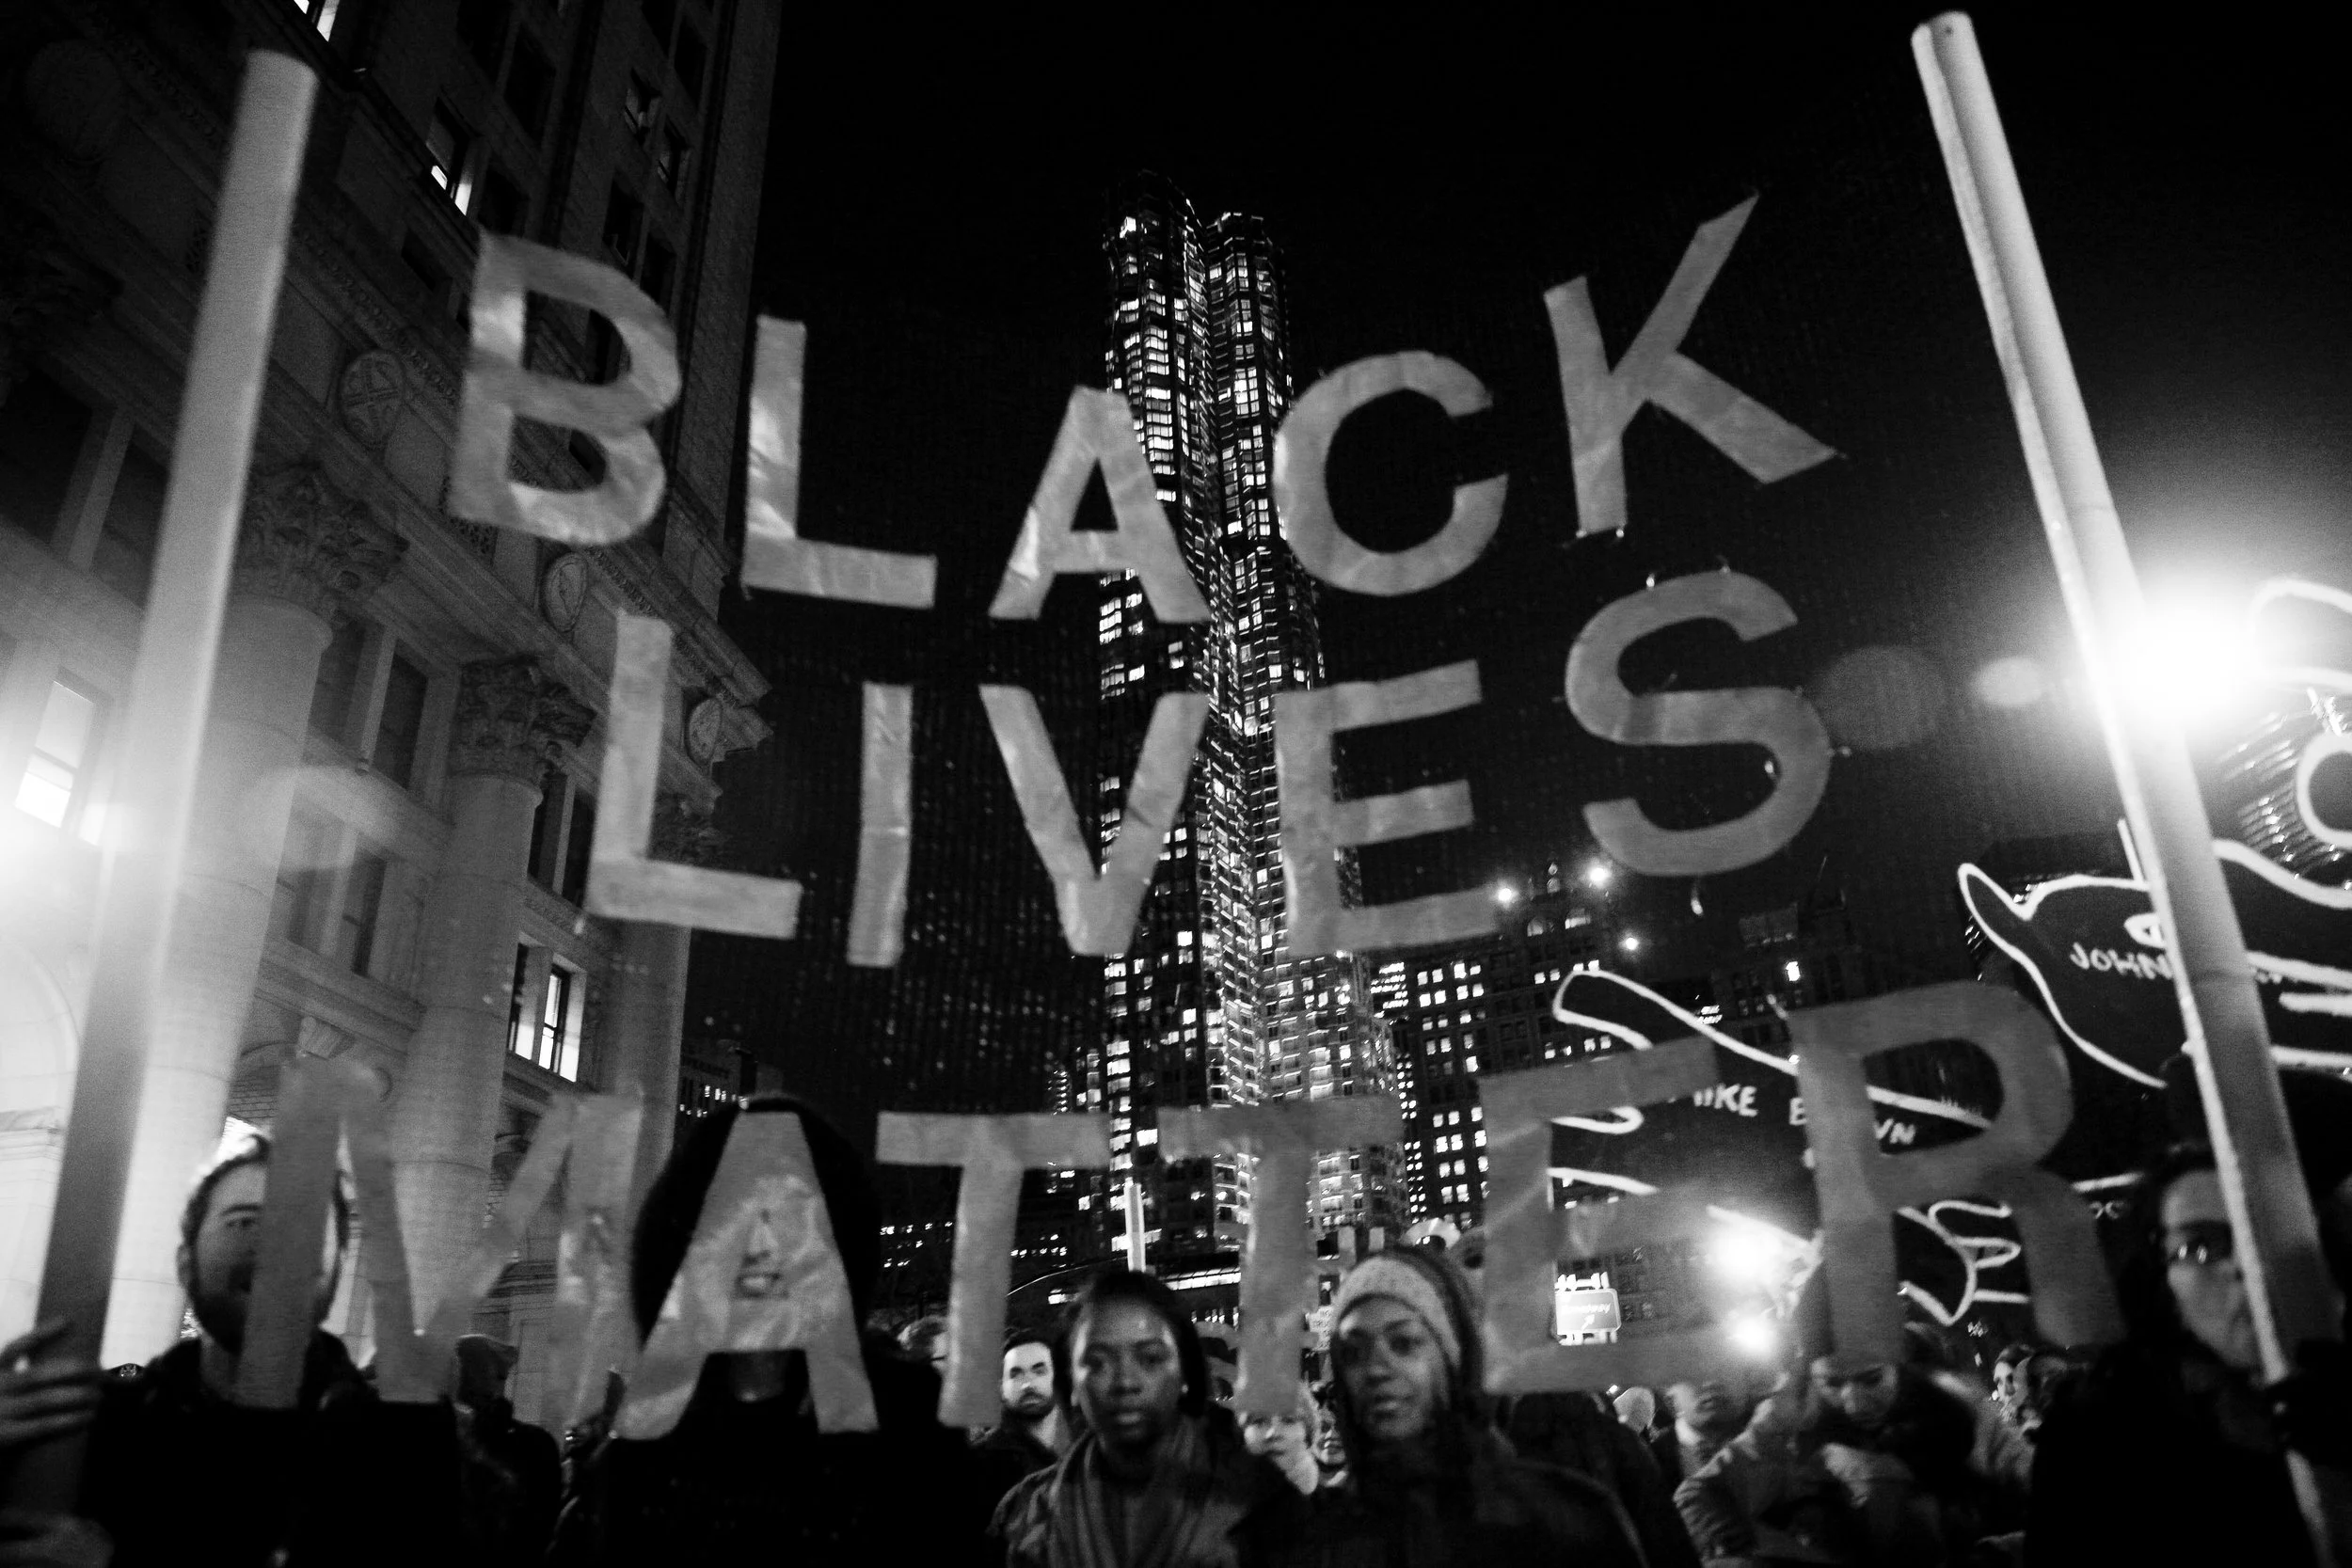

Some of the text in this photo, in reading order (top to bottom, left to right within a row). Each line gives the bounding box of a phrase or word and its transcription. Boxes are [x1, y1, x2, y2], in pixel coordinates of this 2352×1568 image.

[446, 193, 1840, 624] BLACK
[585, 567, 1834, 968] LIVES
[2069, 942, 2174, 980] JOHN
[232, 980, 2130, 1440] MATTER
